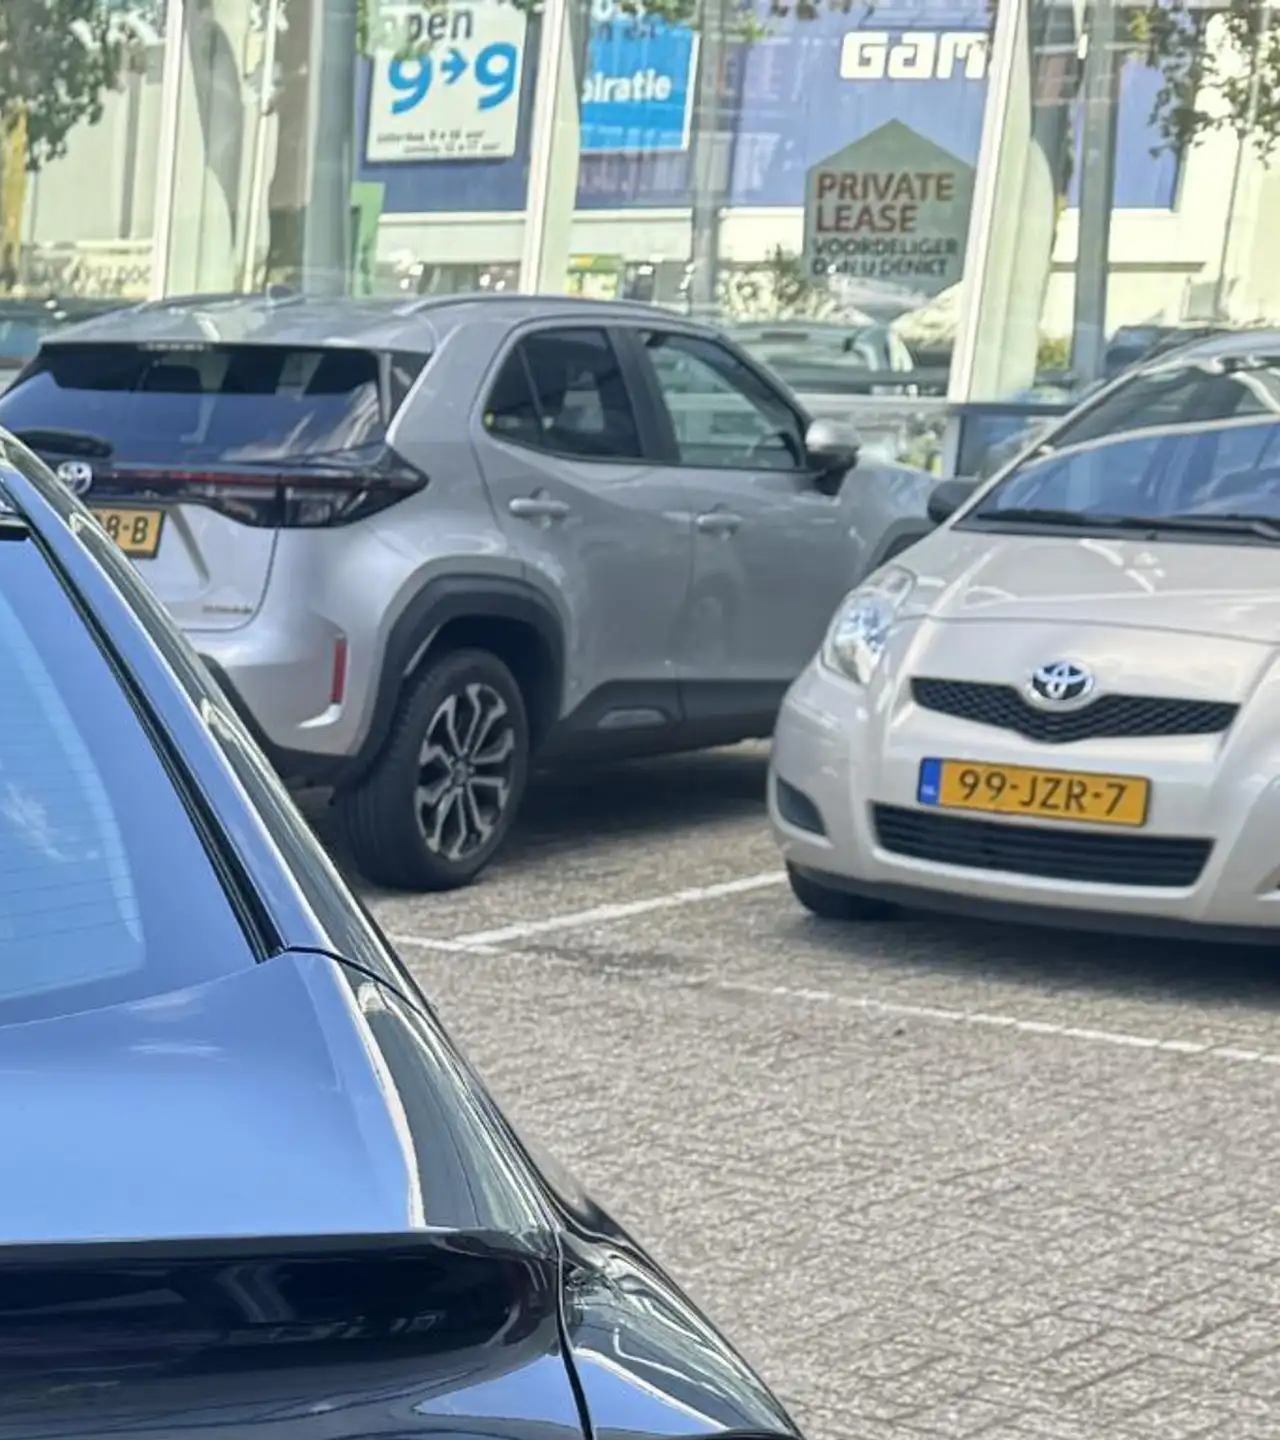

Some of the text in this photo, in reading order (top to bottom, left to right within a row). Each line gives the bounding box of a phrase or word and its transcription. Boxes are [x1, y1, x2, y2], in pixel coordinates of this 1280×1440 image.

[816, 171, 955, 202] PRIVATE
[816, 204, 919, 233] LEASE
[958, 769, 1129, 816] 99-JZR-7
